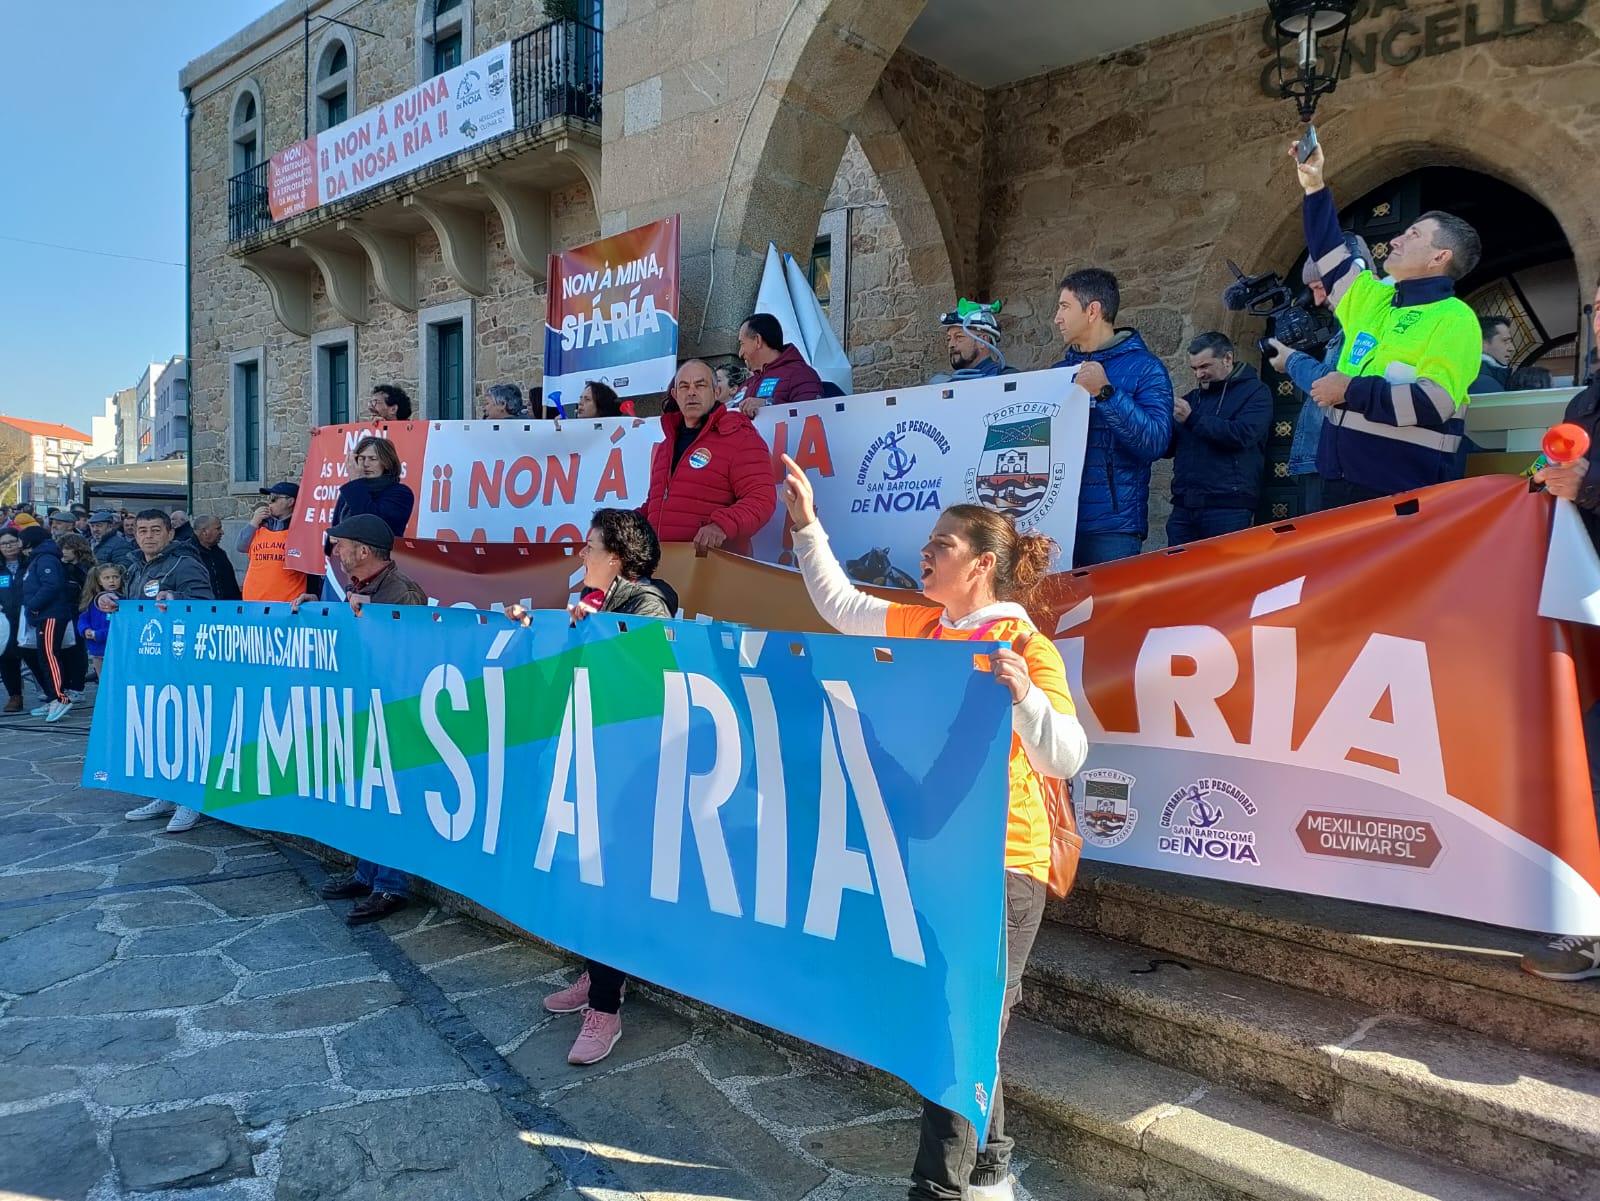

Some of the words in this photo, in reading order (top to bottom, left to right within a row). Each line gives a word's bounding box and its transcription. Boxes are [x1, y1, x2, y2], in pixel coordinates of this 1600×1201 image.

[462, 93, 482, 108] NOIA
[334, 122, 371, 164] NON
[377, 105, 388, 139] Á
[394, 76, 449, 128] RUINA
[283, 146, 300, 163] NON
[326, 170, 347, 199] DA
[352, 141, 398, 185] NOSA
[403, 117, 432, 157] RÍA
[562, 270, 599, 300] NON
[615, 252, 664, 287] MINA,
[561, 312, 585, 351] SI
[588, 293, 608, 347] Á
[610, 283, 660, 342] RÍA
[993, 403, 1049, 420] PORTOSIN
[857, 436, 885, 485] CONFRARIA
[896, 421, 907, 434] DE
[908, 420, 950, 455] PESCADORES
[320, 458, 332, 478] ÁS
[468, 453, 581, 509] NON
[594, 425, 628, 502] Á
[867, 482, 884, 492] SAN
[887, 476, 943, 491] BARTOLOMÉ
[851, 498, 871, 513] DE
[873, 490, 941, 513] NOIA
[1021, 468, 1062, 528] PESCADORES
[318, 509, 327, 523] A
[144, 646, 162, 655] NOIA
[194, 623, 339, 672] #STOPMINASANFINX
[1135, 575, 1448, 795] RÍA
[125, 684, 212, 785] NON
[216, 687, 244, 793] A
[257, 686, 402, 815] MINA
[419, 629, 515, 855] SÍ
[534, 667, 604, 887] A
[650, 631, 926, 968] RÍA
[1161, 788, 1187, 827] CONFRARIA
[1199, 780, 1209, 789] DE
[1211, 780, 1256, 815] PESCADORES
[1173, 826, 1192, 835] SAN
[1195, 828, 1254, 843] BARTOLOMÉ
[1308, 815, 1426, 842] MEXILLOEIROS
[1159, 838, 1179, 851] DE
[1183, 836, 1257, 863] NOIA
[1320, 833, 1392, 855] OLVIMAR
[1394, 841, 1416, 859] SL
